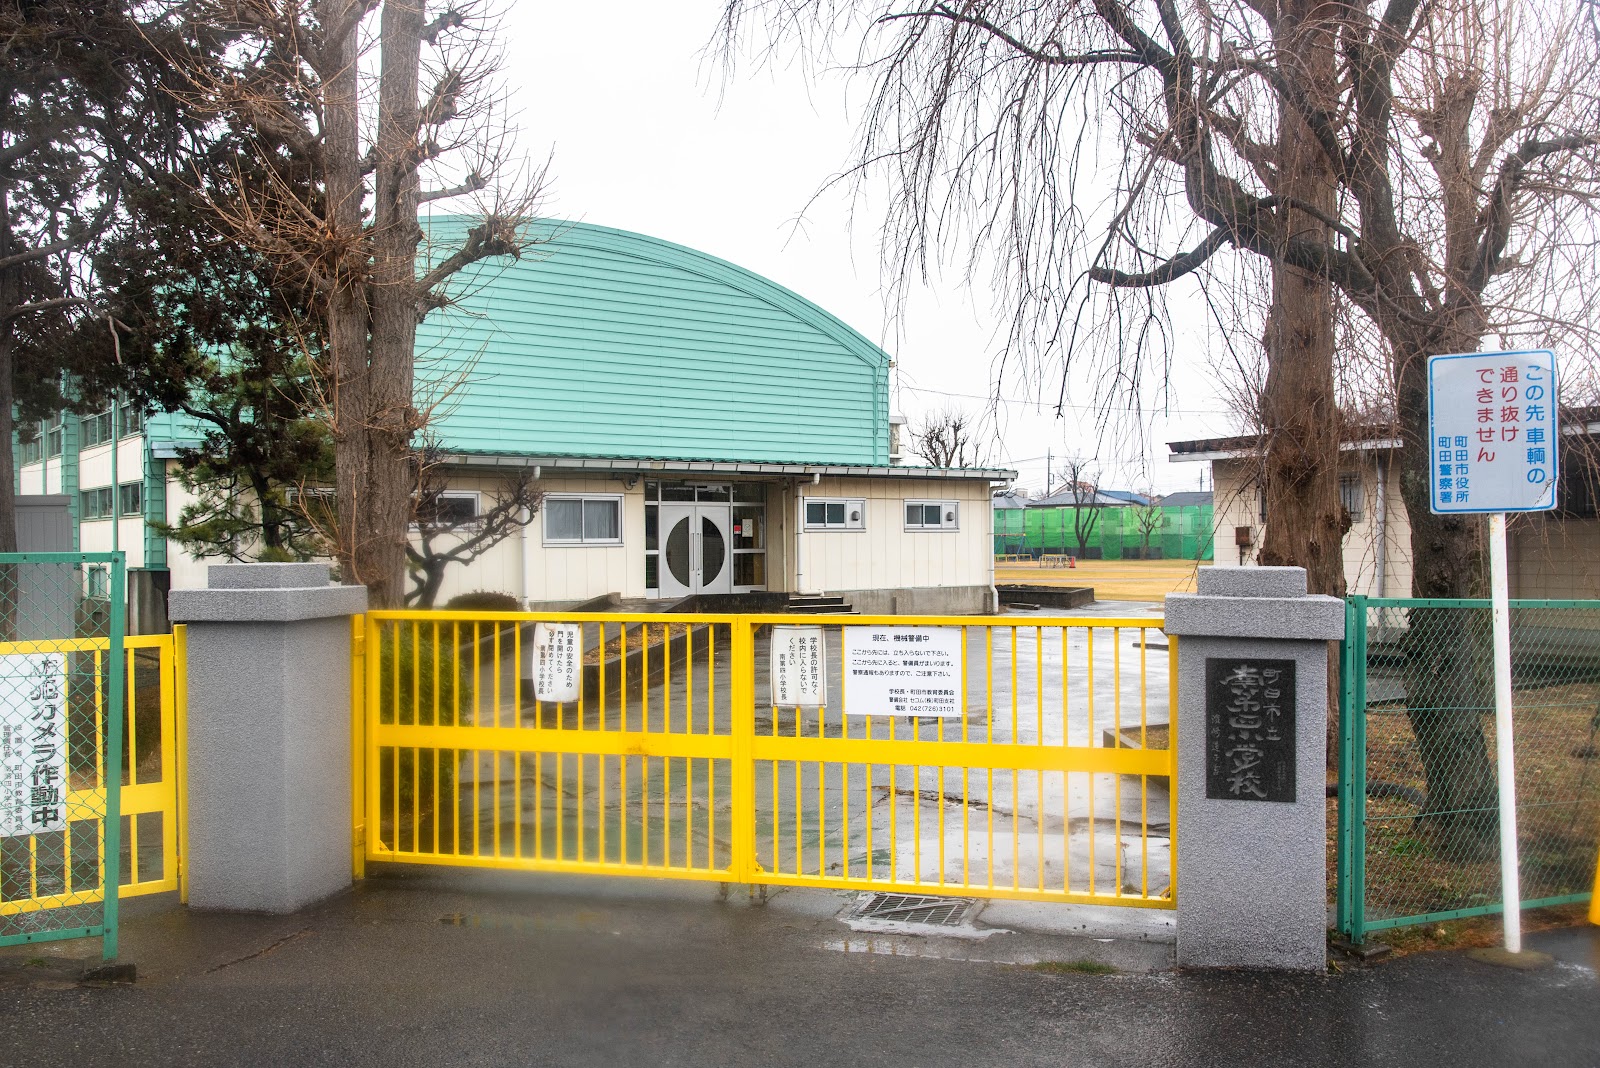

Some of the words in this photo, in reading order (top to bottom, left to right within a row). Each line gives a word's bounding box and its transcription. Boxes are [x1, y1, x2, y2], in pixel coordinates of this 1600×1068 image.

[1476, 368, 1495, 463] できません
[1500, 366, 1519, 442] 通り抜け
[1438, 436, 1453, 503] 町田警察署
[1454, 435, 1470, 503] 町田市役所
[556, 630, 564, 674] 門を開けたら
[565, 630, 574, 688] 児童の安全のため
[788, 637, 797, 666] ください
[798, 637, 808, 694] 校内に入らないで
[809, 637, 818, 696] 学校長の許可なく
[1262, 668, 1282, 741] 町田市立
